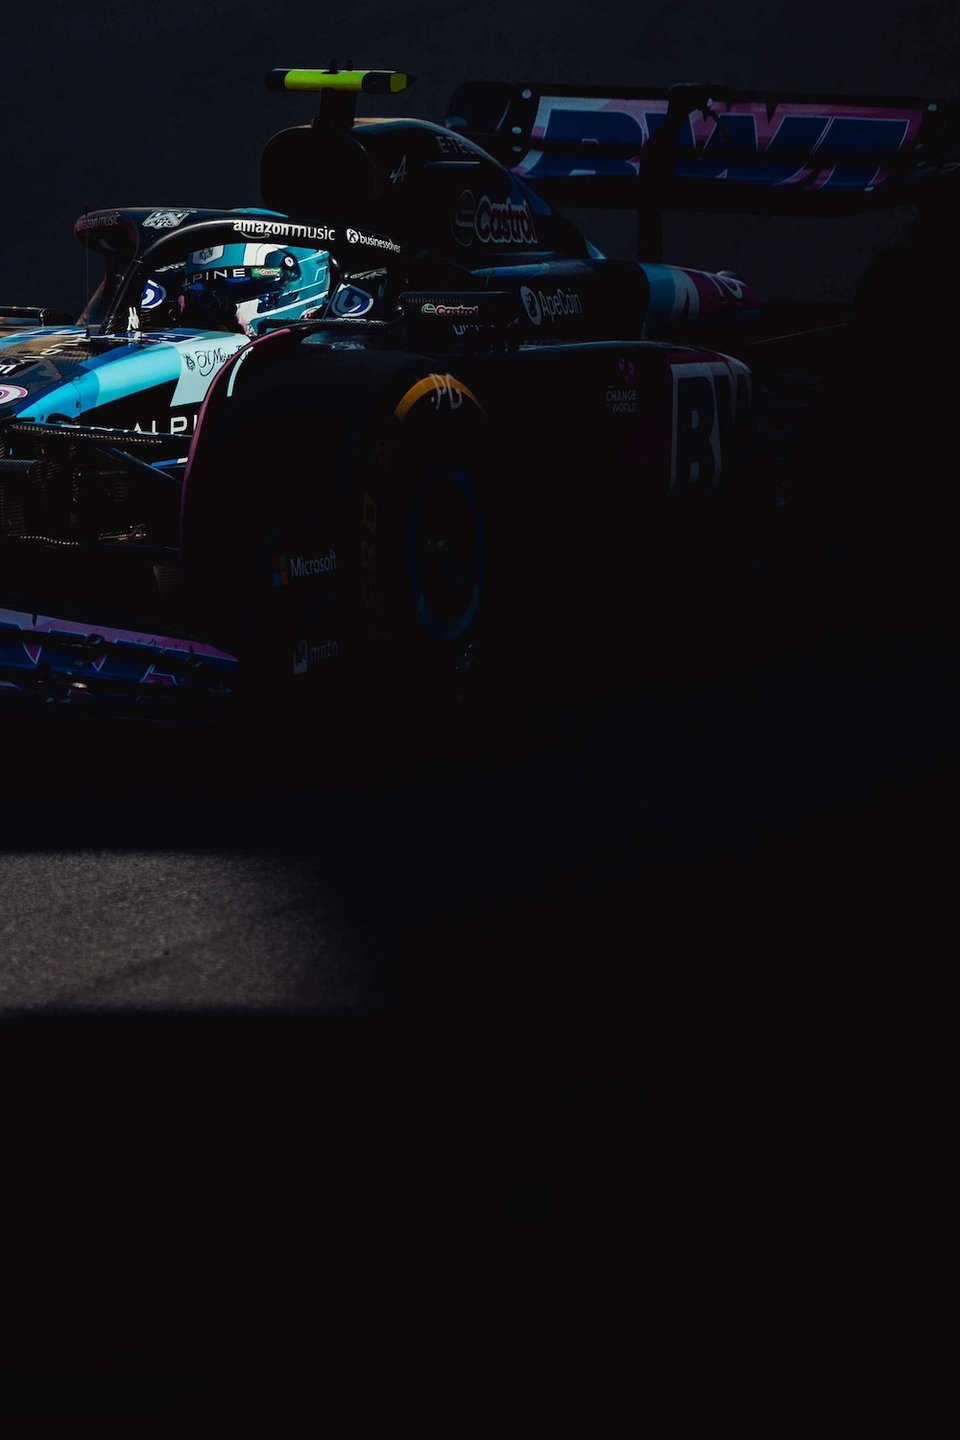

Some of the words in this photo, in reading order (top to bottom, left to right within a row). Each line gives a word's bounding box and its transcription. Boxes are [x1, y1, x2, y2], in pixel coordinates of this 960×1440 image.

[233, 221, 289, 238] amazon
[290, 224, 336, 241] music
[474, 194, 538, 244] Castrol
[435, 304, 480, 317] Castrol
[538, 288, 585, 323] ApeCoin
